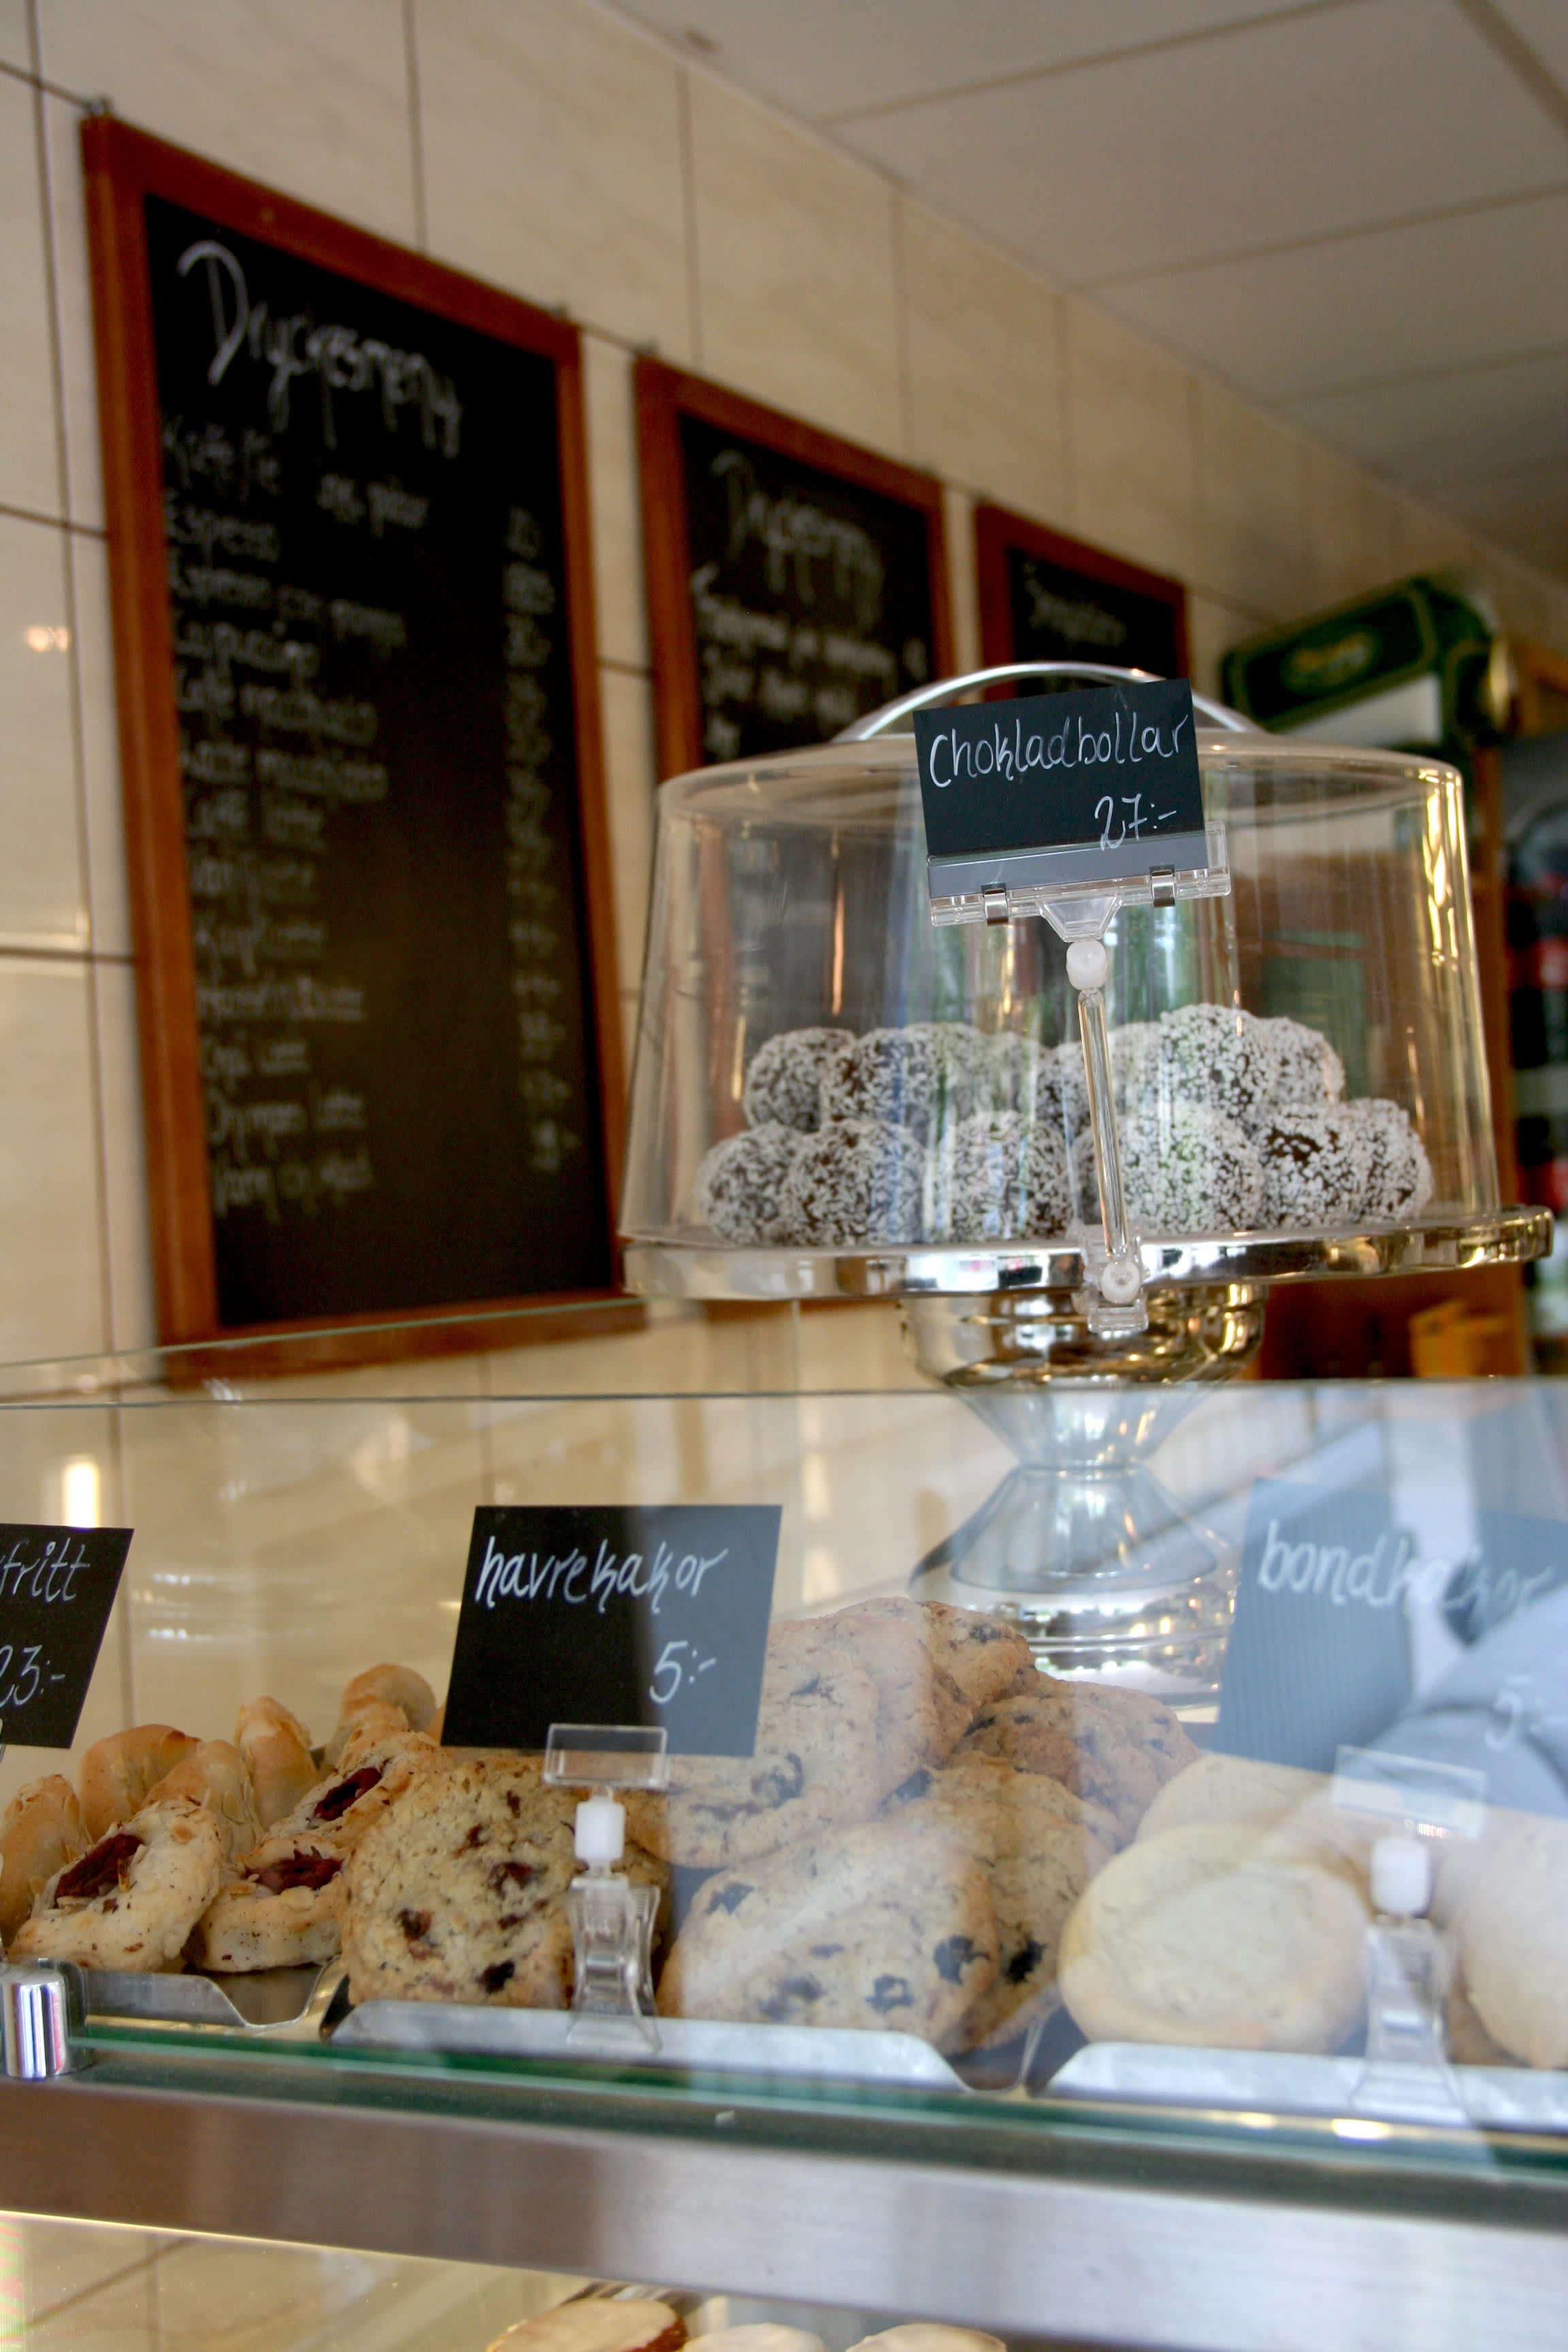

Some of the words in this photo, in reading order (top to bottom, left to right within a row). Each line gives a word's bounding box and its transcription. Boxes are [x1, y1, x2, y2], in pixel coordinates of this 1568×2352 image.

[930, 711, 1189, 788] Chokladbollar
[1094, 793, 1177, 851] 27:-
[474, 1535, 729, 1614] havrekakor
[649, 1640, 717, 1703] 5:-
